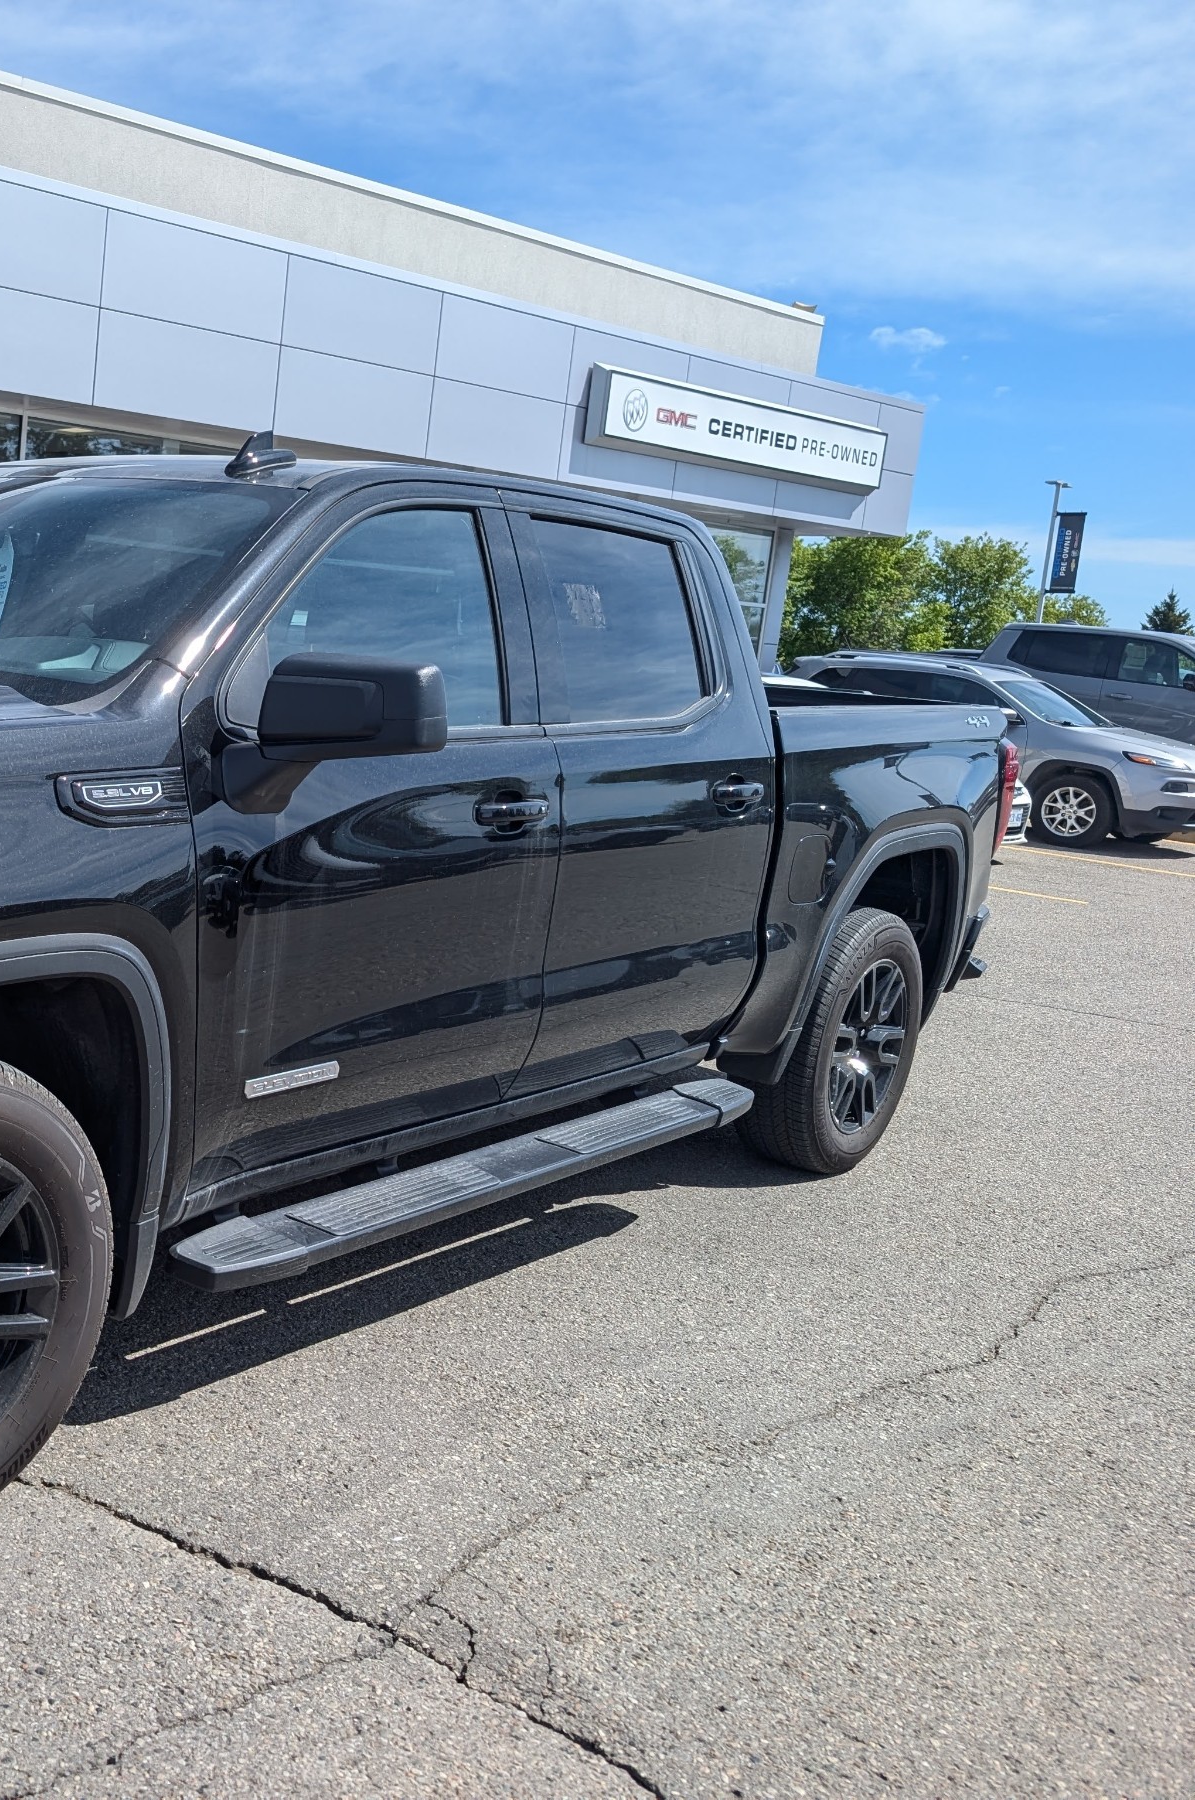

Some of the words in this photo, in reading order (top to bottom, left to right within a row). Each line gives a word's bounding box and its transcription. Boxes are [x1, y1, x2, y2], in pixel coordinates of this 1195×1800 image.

[656, 407, 698, 430] GMC
[708, 418, 797, 451] CERTIFIED
[800, 437, 878, 467] PRE-OWNED
[1053, 528, 1066, 578] CERTIFIED
[1059, 529, 1072, 577] PRE-OWNED
